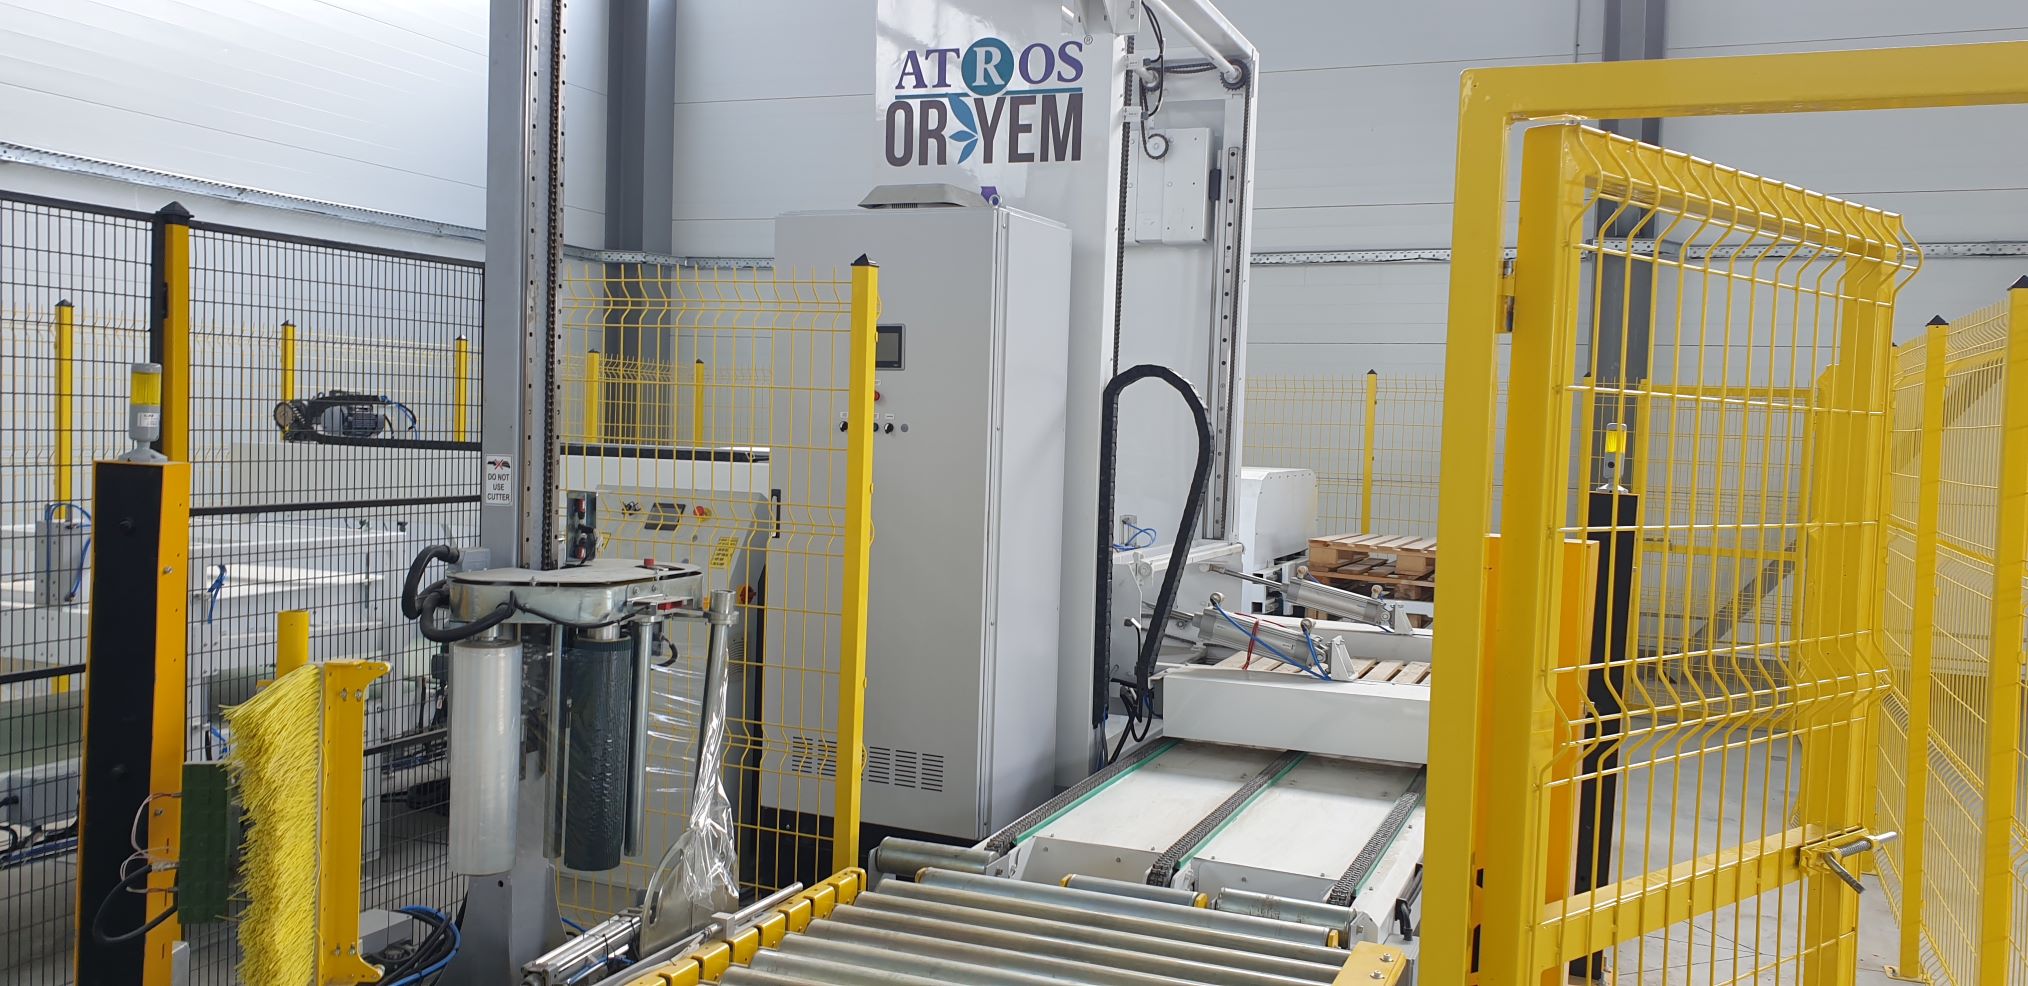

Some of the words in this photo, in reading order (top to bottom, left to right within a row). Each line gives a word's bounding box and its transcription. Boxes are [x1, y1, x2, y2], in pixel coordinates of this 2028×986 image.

[895, 39, 1084, 90] ATROS
[487, 473, 497, 481] DO
[498, 473, 510, 481] NOT
[492, 483, 505, 491] USE
[487, 493, 510, 501] CUTTER
